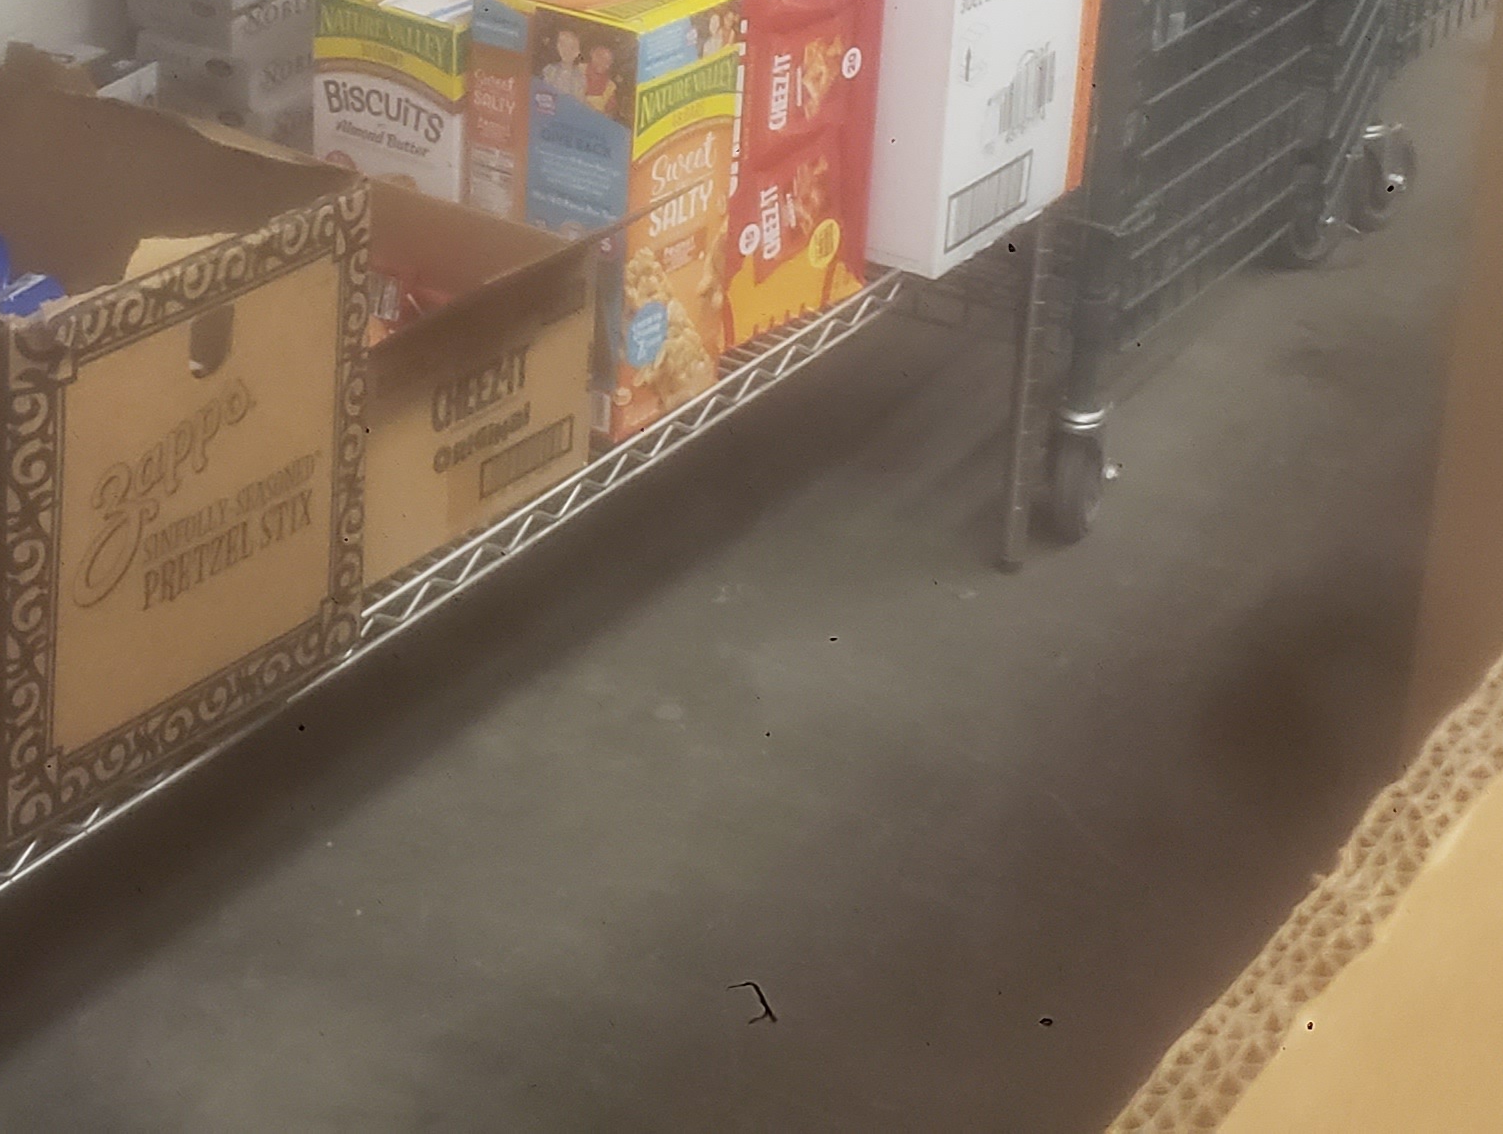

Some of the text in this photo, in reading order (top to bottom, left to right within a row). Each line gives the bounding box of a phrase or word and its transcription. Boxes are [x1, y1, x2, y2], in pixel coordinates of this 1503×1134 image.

[321, 6, 449, 67] NATURE VALLEY
[640, 59, 737, 130] NATURE VALLEY
[334, 117, 431, 158] Almond Butter
[650, 130, 717, 197] Sweet
[648, 174, 714, 238] SALTY
[142, 488, 315, 611] PRETZEL STIX
